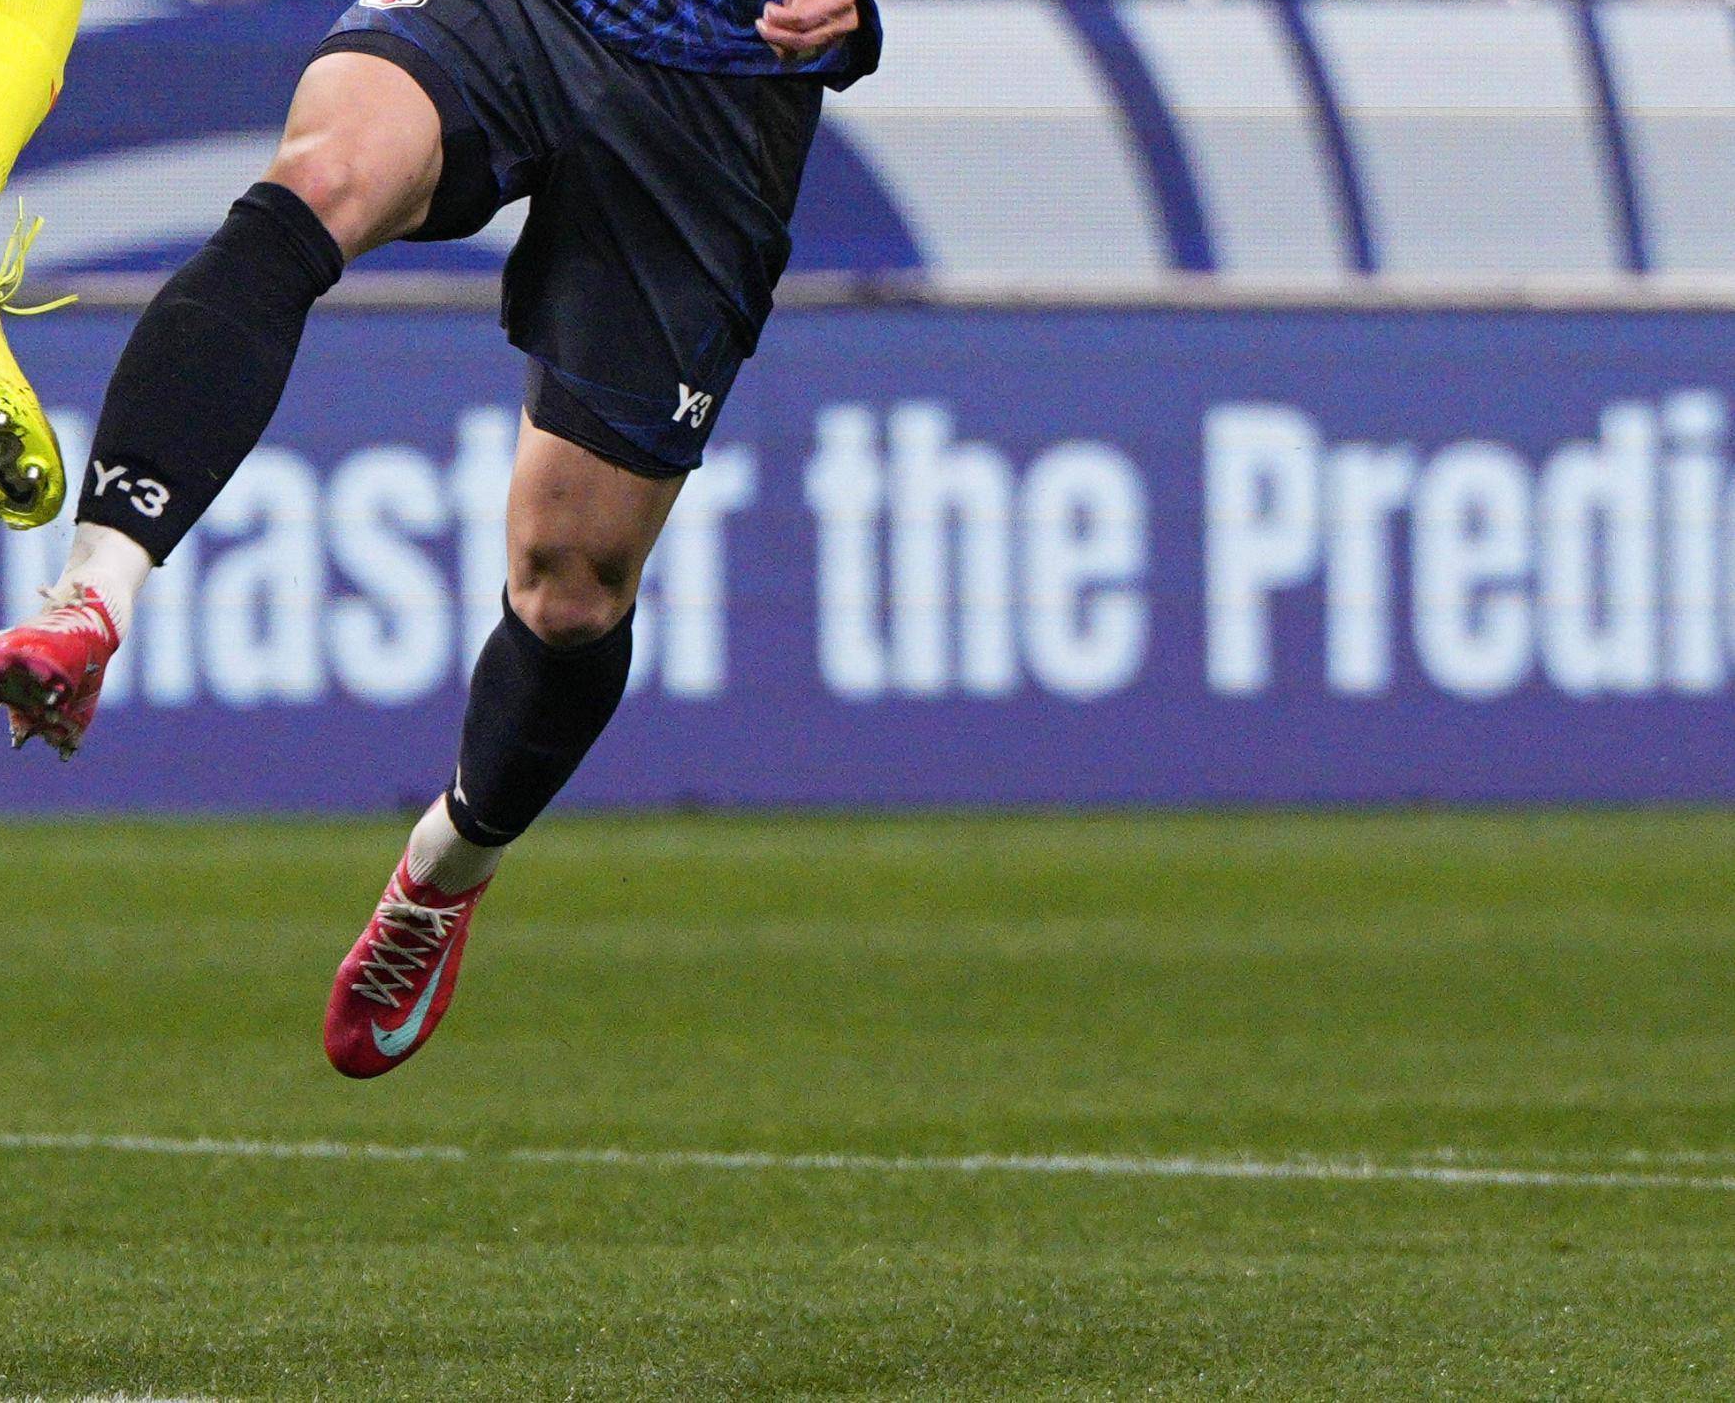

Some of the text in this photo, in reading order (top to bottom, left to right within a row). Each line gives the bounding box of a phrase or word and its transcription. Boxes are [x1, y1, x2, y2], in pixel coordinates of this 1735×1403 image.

[672, 382, 712, 428] Y-3
[93, 460, 171, 518] Y-3
[4, 390, 1735, 707] astr the Predi
